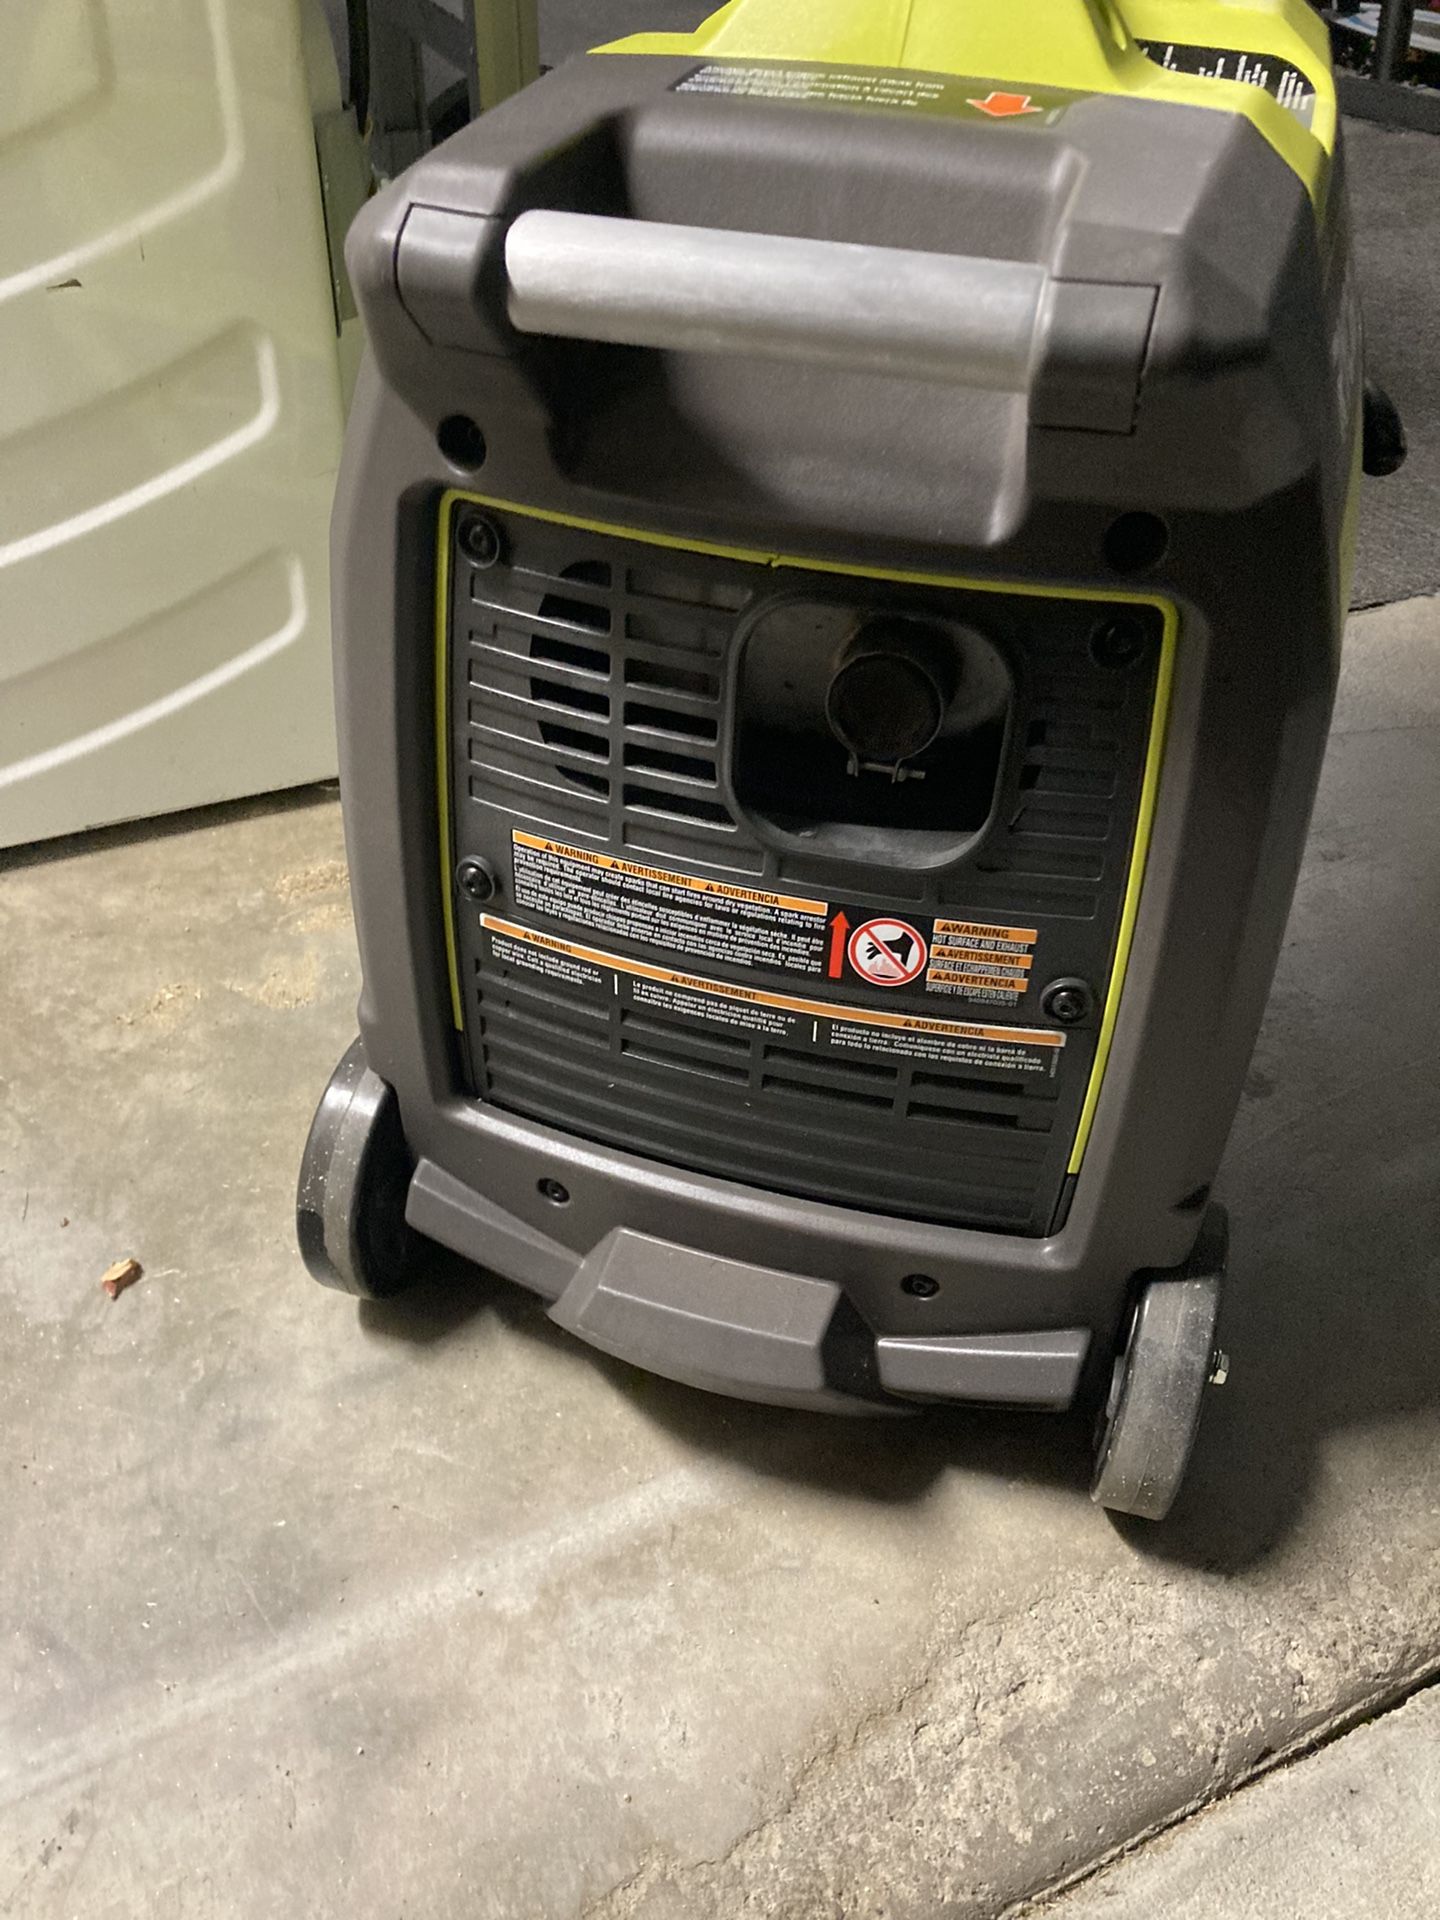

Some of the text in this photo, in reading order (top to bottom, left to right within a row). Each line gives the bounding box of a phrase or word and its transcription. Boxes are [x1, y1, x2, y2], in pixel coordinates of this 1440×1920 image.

[555, 844, 780, 905] WARNING AVERTISSEMENT ADVERTENCIA
[952, 923, 1008, 939] WARNING
[532, 934, 572, 953] WARNING
[932, 935, 946, 944] HOT
[948, 936, 980, 948] SURFACE
[981, 940, 994, 950] AND
[948, 949, 1021, 965] AVERTISSEMENT
[681, 976, 756, 1000] AVERTISSEMENT
[942, 973, 1016, 989] ADVERTENCIA
[914, 1020, 984, 1037] ADVERTENCIA
